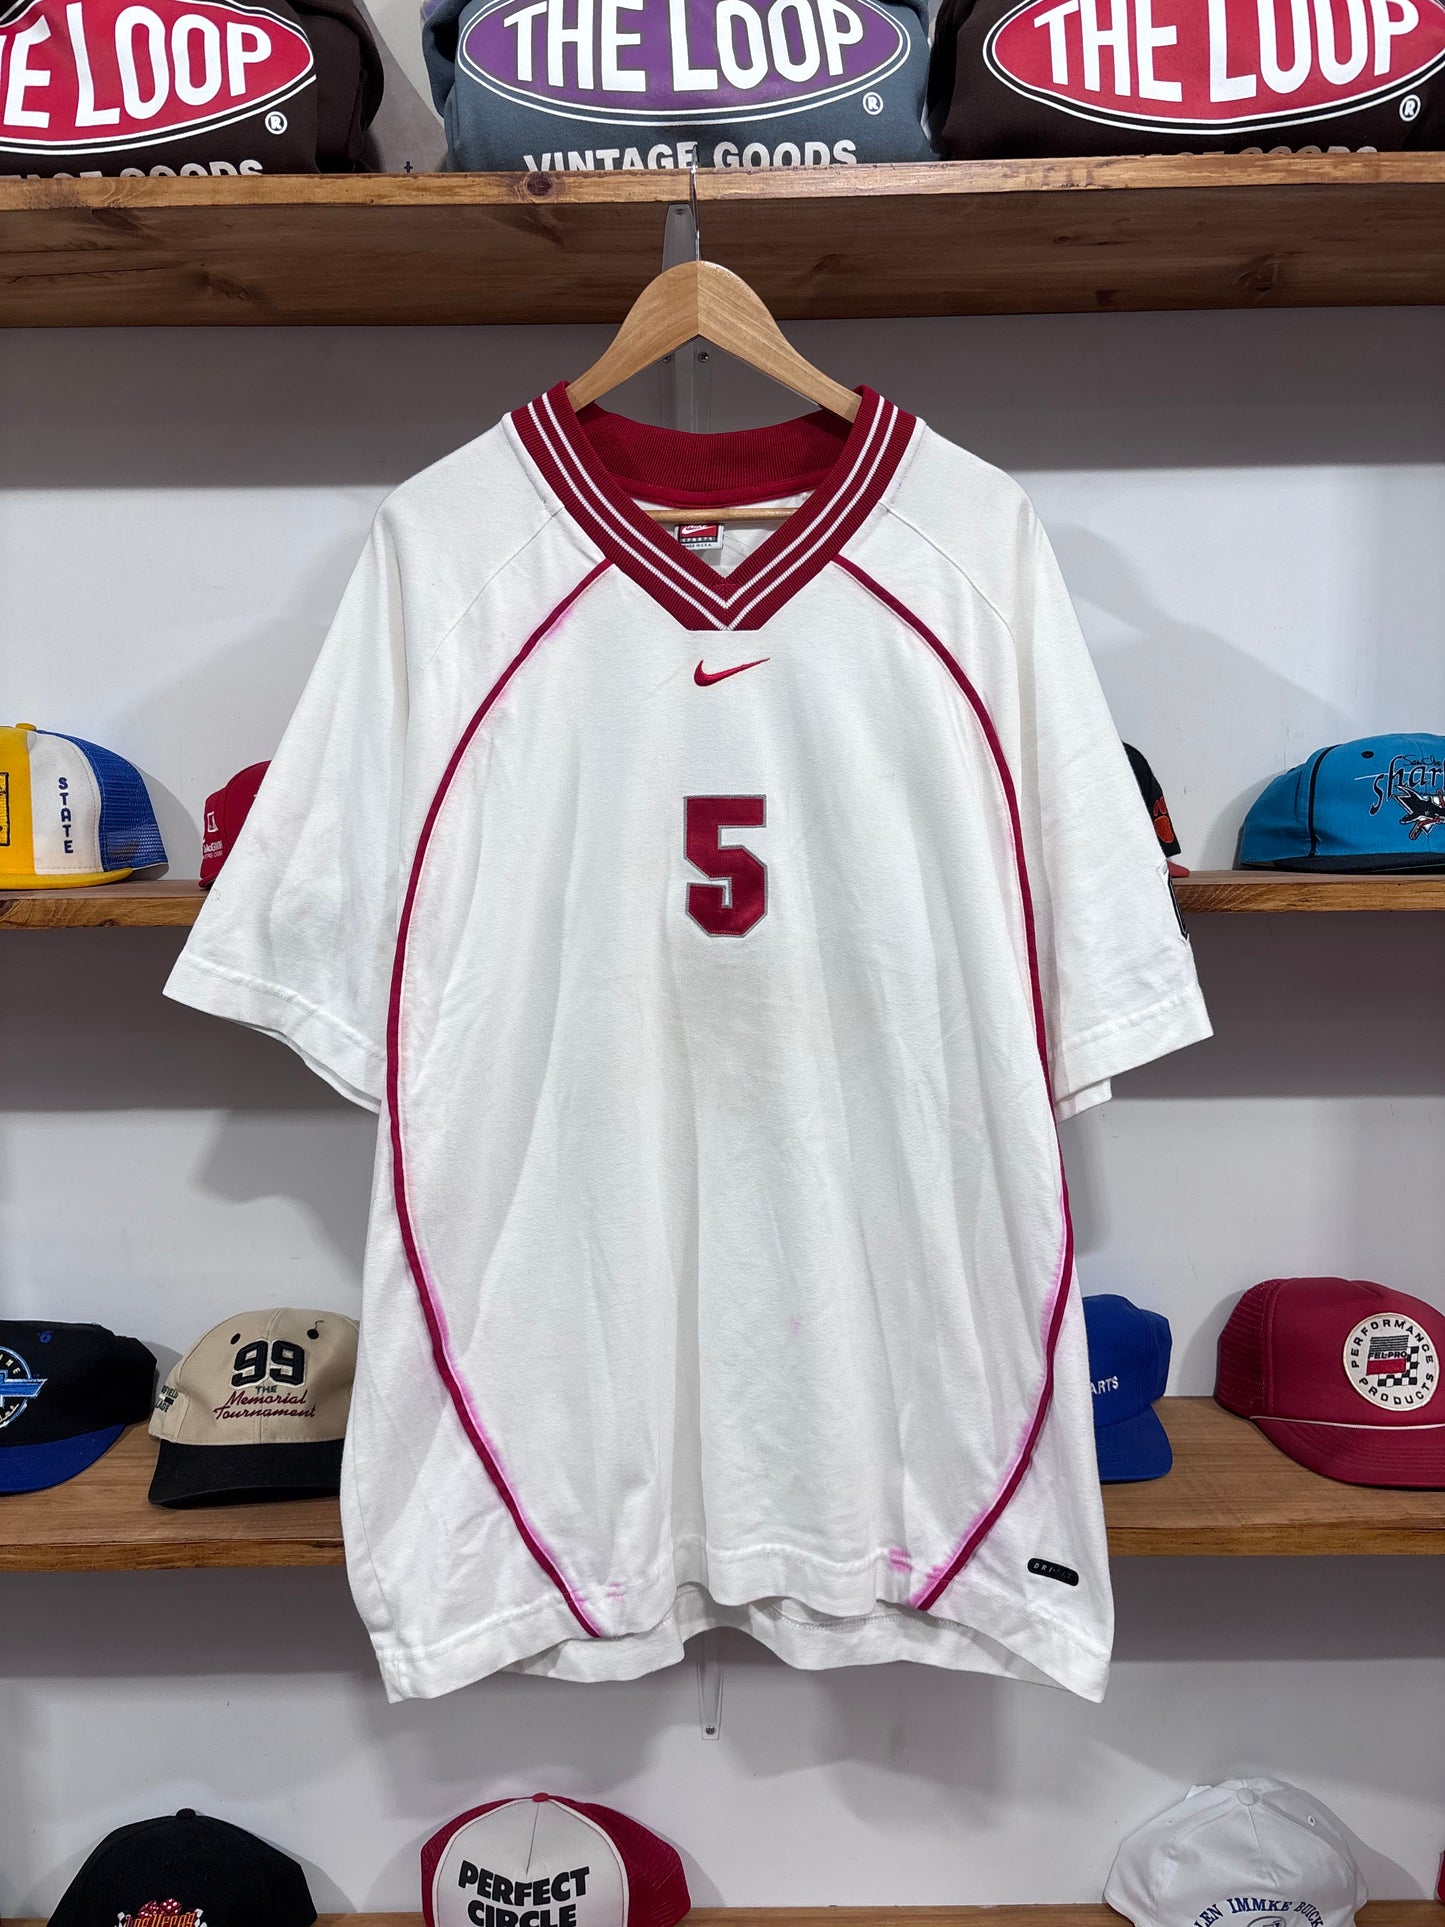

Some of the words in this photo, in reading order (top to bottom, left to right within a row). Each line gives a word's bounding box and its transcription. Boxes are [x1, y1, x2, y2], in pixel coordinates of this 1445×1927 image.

[66, 2, 272, 128] LOOP
[503, 0, 647, 92] THE
[669, 0, 864, 91] LOOP
[713, 140, 857, 167] GOODS
[58, 776, 74, 854] STATE
[683, 794, 768, 938] 5
[230, 1338, 306, 1389] 99
[1351, 1319, 1434, 1369] PERFORMANCE
[224, 1389, 308, 1406] Memorial
[255, 1385, 278, 1394] THE
[1359, 1373, 1434, 1405] PRODUCTS
[213, 1404, 317, 1420] Tournament
[458, 1859, 590, 1907] PERFECT
[467, 1899, 577, 1927] CIRCLE
[1226, 1897, 1292, 1914] IMMKE
